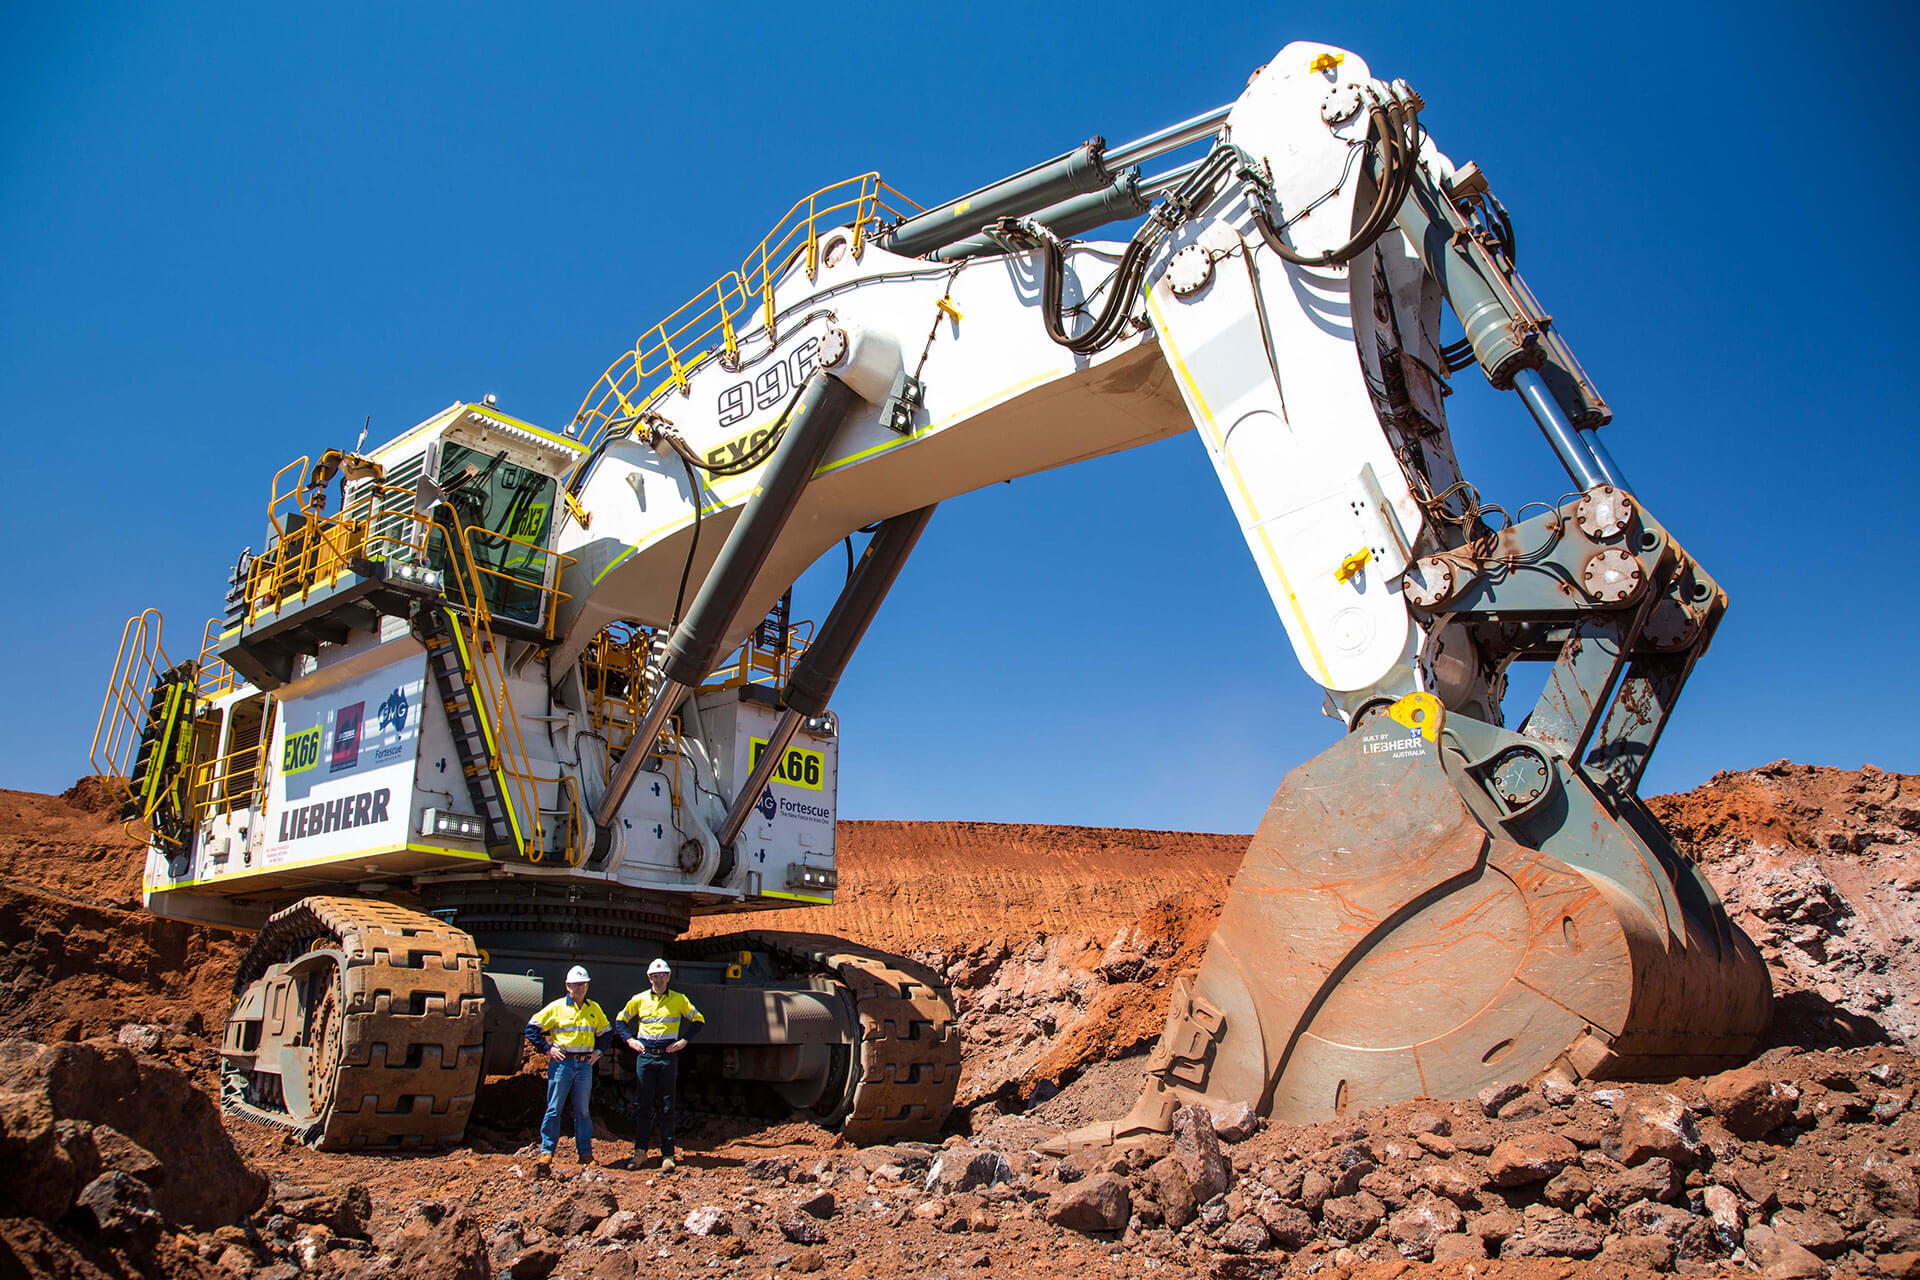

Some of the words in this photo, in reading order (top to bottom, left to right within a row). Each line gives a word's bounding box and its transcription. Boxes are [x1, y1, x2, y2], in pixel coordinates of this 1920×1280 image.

[282, 731, 319, 772] EX66
[375, 745, 403, 759] Fortescue
[1392, 749, 1426, 759] AUSTRALIA
[279, 788, 391, 843] LIEBHERR
[780, 797, 830, 818] Fortescue
